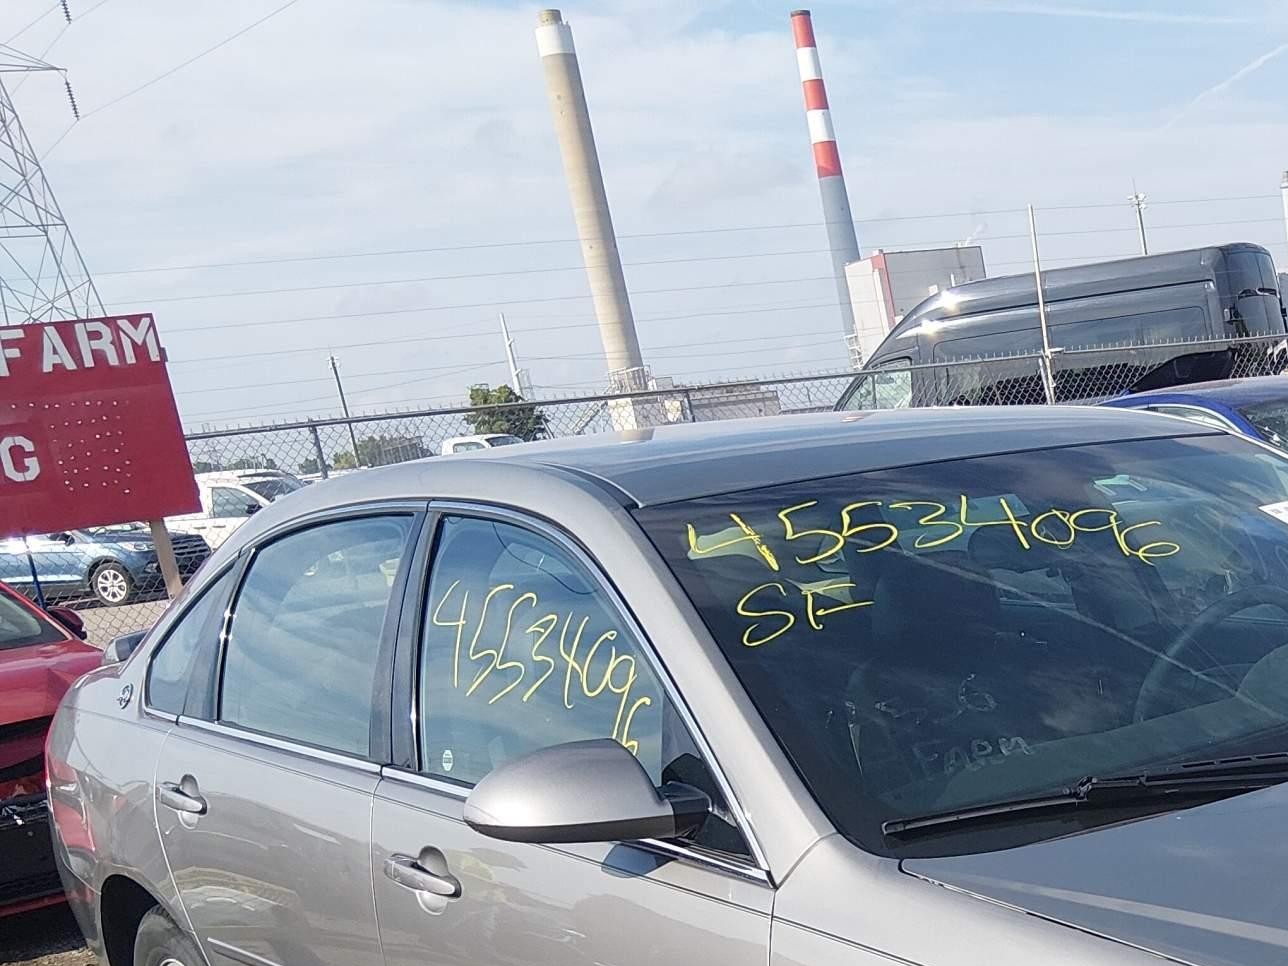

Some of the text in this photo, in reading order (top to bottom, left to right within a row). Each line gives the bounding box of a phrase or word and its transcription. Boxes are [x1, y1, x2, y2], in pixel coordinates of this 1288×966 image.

[0, 317, 161, 377] FARM
[686, 494, 1181, 572] 45534096
[737, 583, 875, 647] SF
